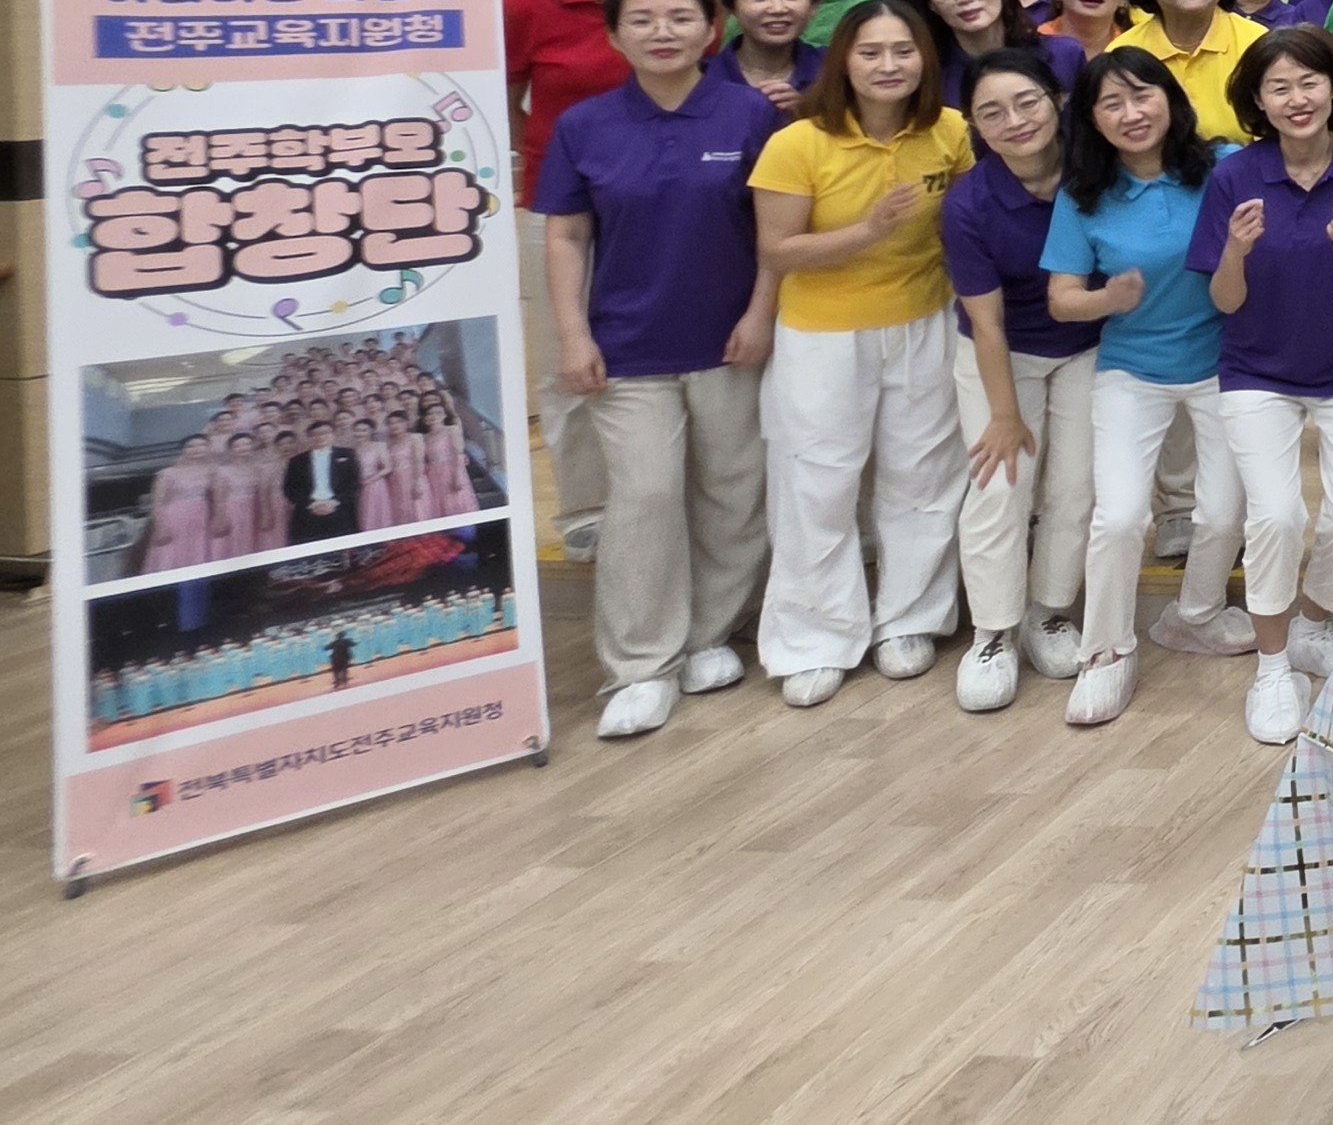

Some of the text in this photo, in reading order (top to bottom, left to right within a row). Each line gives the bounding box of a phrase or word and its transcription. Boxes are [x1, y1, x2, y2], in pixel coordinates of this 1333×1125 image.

[128, 14, 443, 53] 전주교육지원청
[141, 118, 444, 185] 전주학부모
[86, 169, 488, 298] 합창단
[177, 700, 505, 802] 전북특별자치도전주교육지원청
